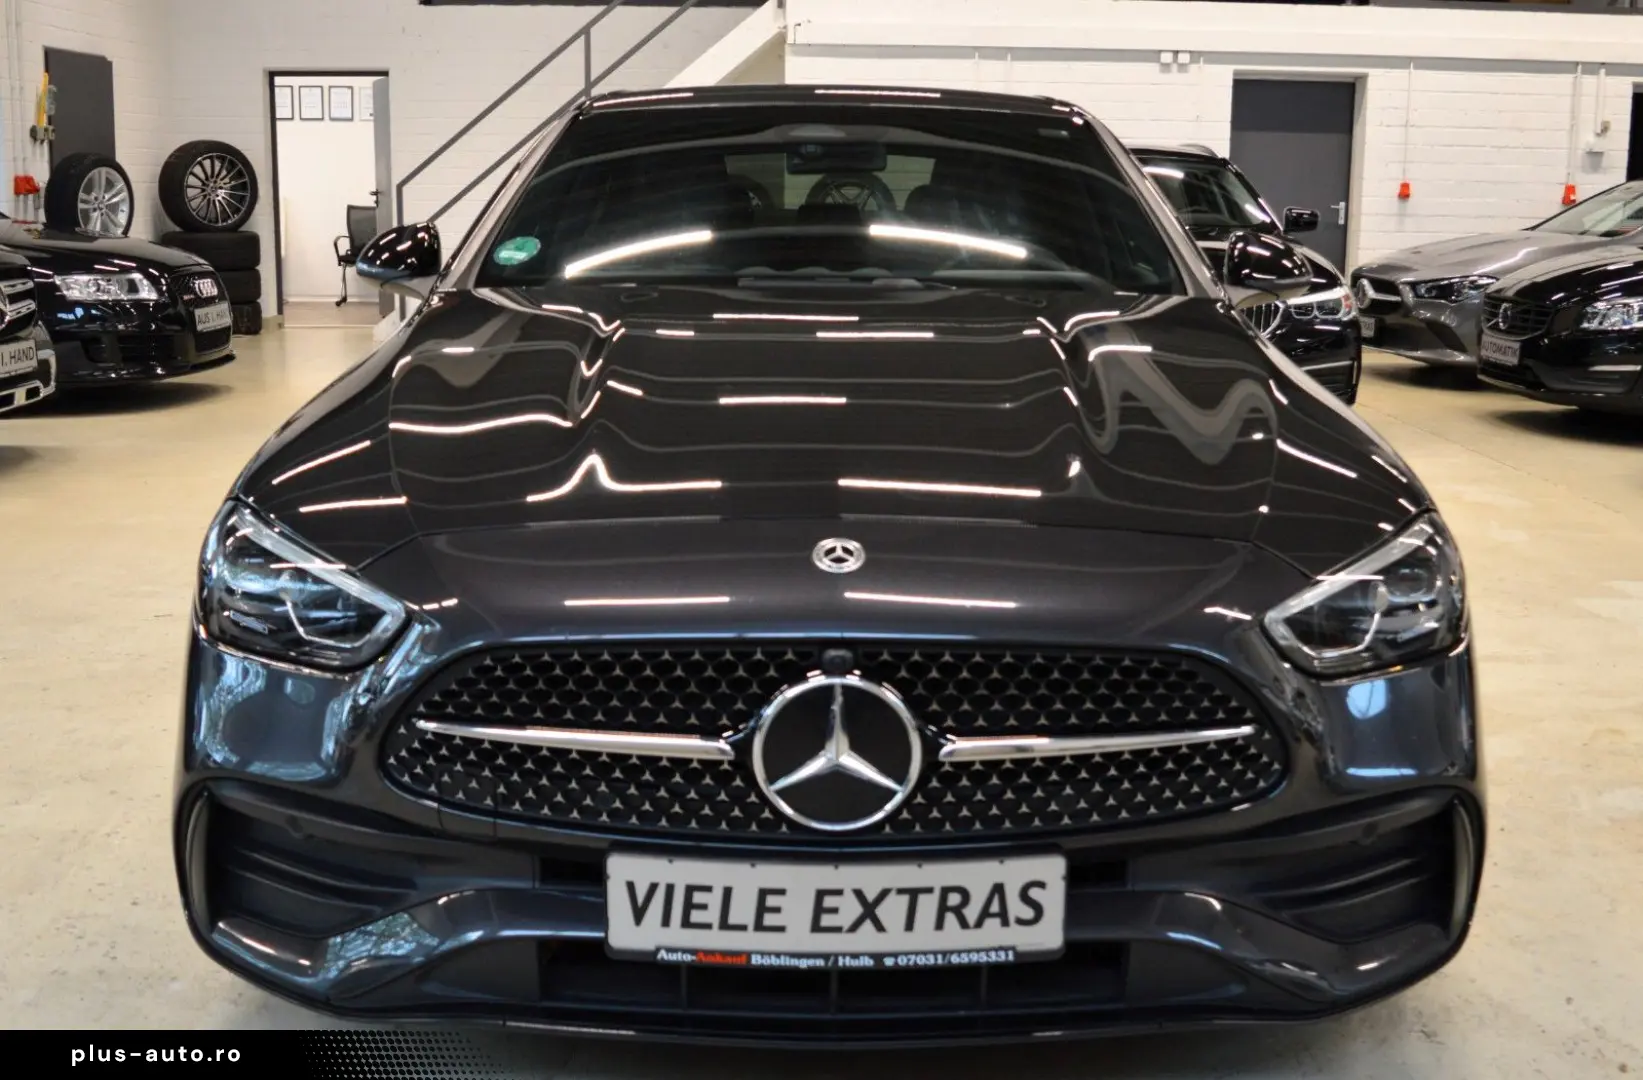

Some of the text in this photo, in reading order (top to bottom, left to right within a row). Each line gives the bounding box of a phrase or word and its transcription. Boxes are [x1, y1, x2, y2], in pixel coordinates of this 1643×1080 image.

[9, 346, 35, 365] HAND
[625, 880, 1048, 933] VIELE EXTRAS
[656, 948, 749, 966] Auto-Ankauf
[751, 953, 825, 969] Böblingen
[838, 955, 874, 968] Hulb
